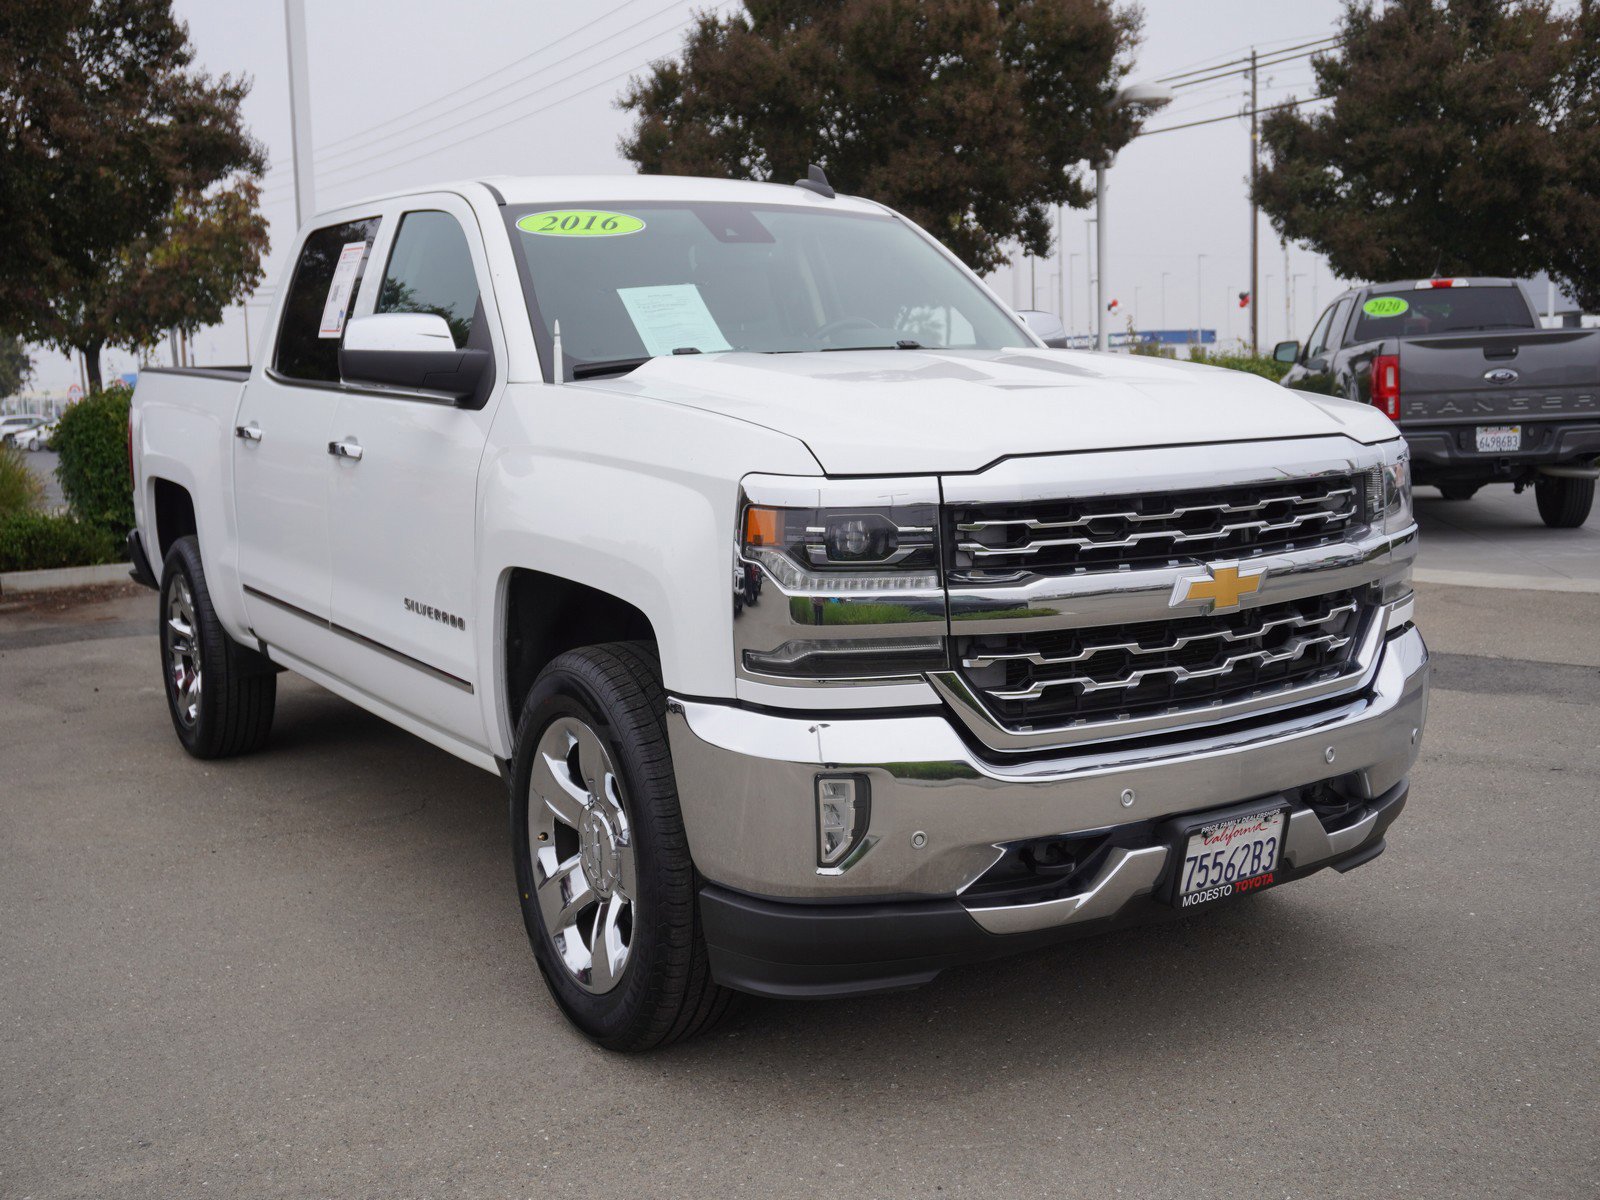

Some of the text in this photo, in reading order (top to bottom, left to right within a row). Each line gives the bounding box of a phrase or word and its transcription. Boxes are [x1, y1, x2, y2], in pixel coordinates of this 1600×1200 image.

[538, 215, 619, 231] 2016
[1370, 301, 1400, 313] 2020
[1406, 395, 1597, 415] RANGER
[404, 597, 466, 631] SILVERADO
[1201, 823, 1220, 834] PRICE
[1201, 822, 1268, 846] California
[1185, 837, 1277, 891] 75562B3
[1182, 872, 1275, 908] MODESTO TOYOTA
